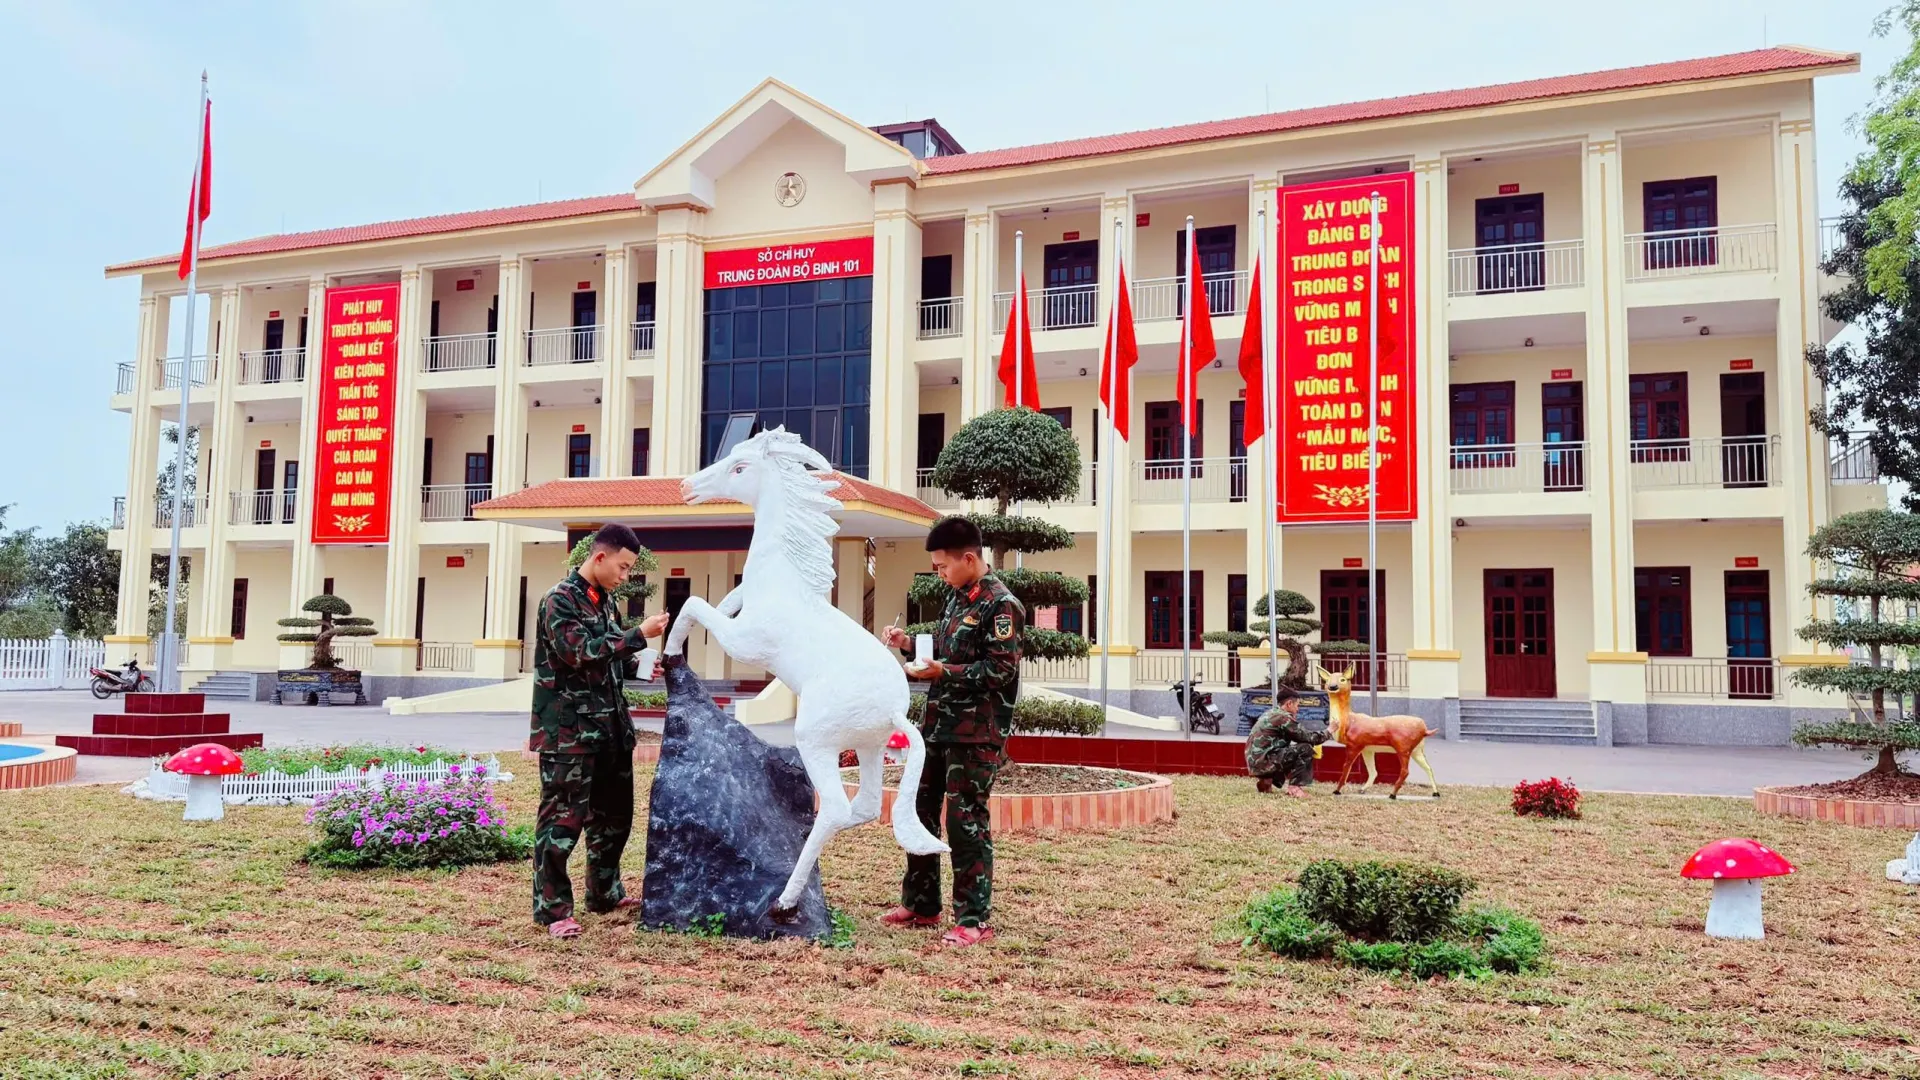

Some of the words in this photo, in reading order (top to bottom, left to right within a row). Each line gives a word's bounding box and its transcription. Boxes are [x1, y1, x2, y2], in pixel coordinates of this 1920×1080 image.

[1302, 200, 1335, 221] XÂY
[1307, 221, 1354, 245] ĐẢNG
[757, 247, 773, 263] SỞ
[774, 246, 793, 261] CHỈ
[793, 247, 816, 260] HUY
[1291, 251, 1347, 272] TRUNG
[717, 269, 755, 284] TRUNG
[756, 263, 790, 280] ĐOÀN
[792, 264, 811, 279] BỘ
[812, 261, 840, 276] BINH
[842, 259, 860, 273] 101
[1292, 276, 1348, 297] TRONG
[1353, 271, 1400, 292] SH
[342, 298, 365, 316] PHÁT
[365, 299, 383, 314] HUY
[1294, 300, 1340, 322] VỮNG
[1305, 326, 1341, 346] TIÊU
[1316, 352, 1353, 370] ĐƠN
[1294, 376, 1340, 397] VỮNG
[336, 404, 360, 422] SÁNG
[361, 405, 379, 423] TẠO
[1300, 400, 1345, 421] TOÀN
[1300, 451, 1337, 472] TIÊU
[335, 471, 353, 486] CAO
[330, 492, 350, 507] ANH
